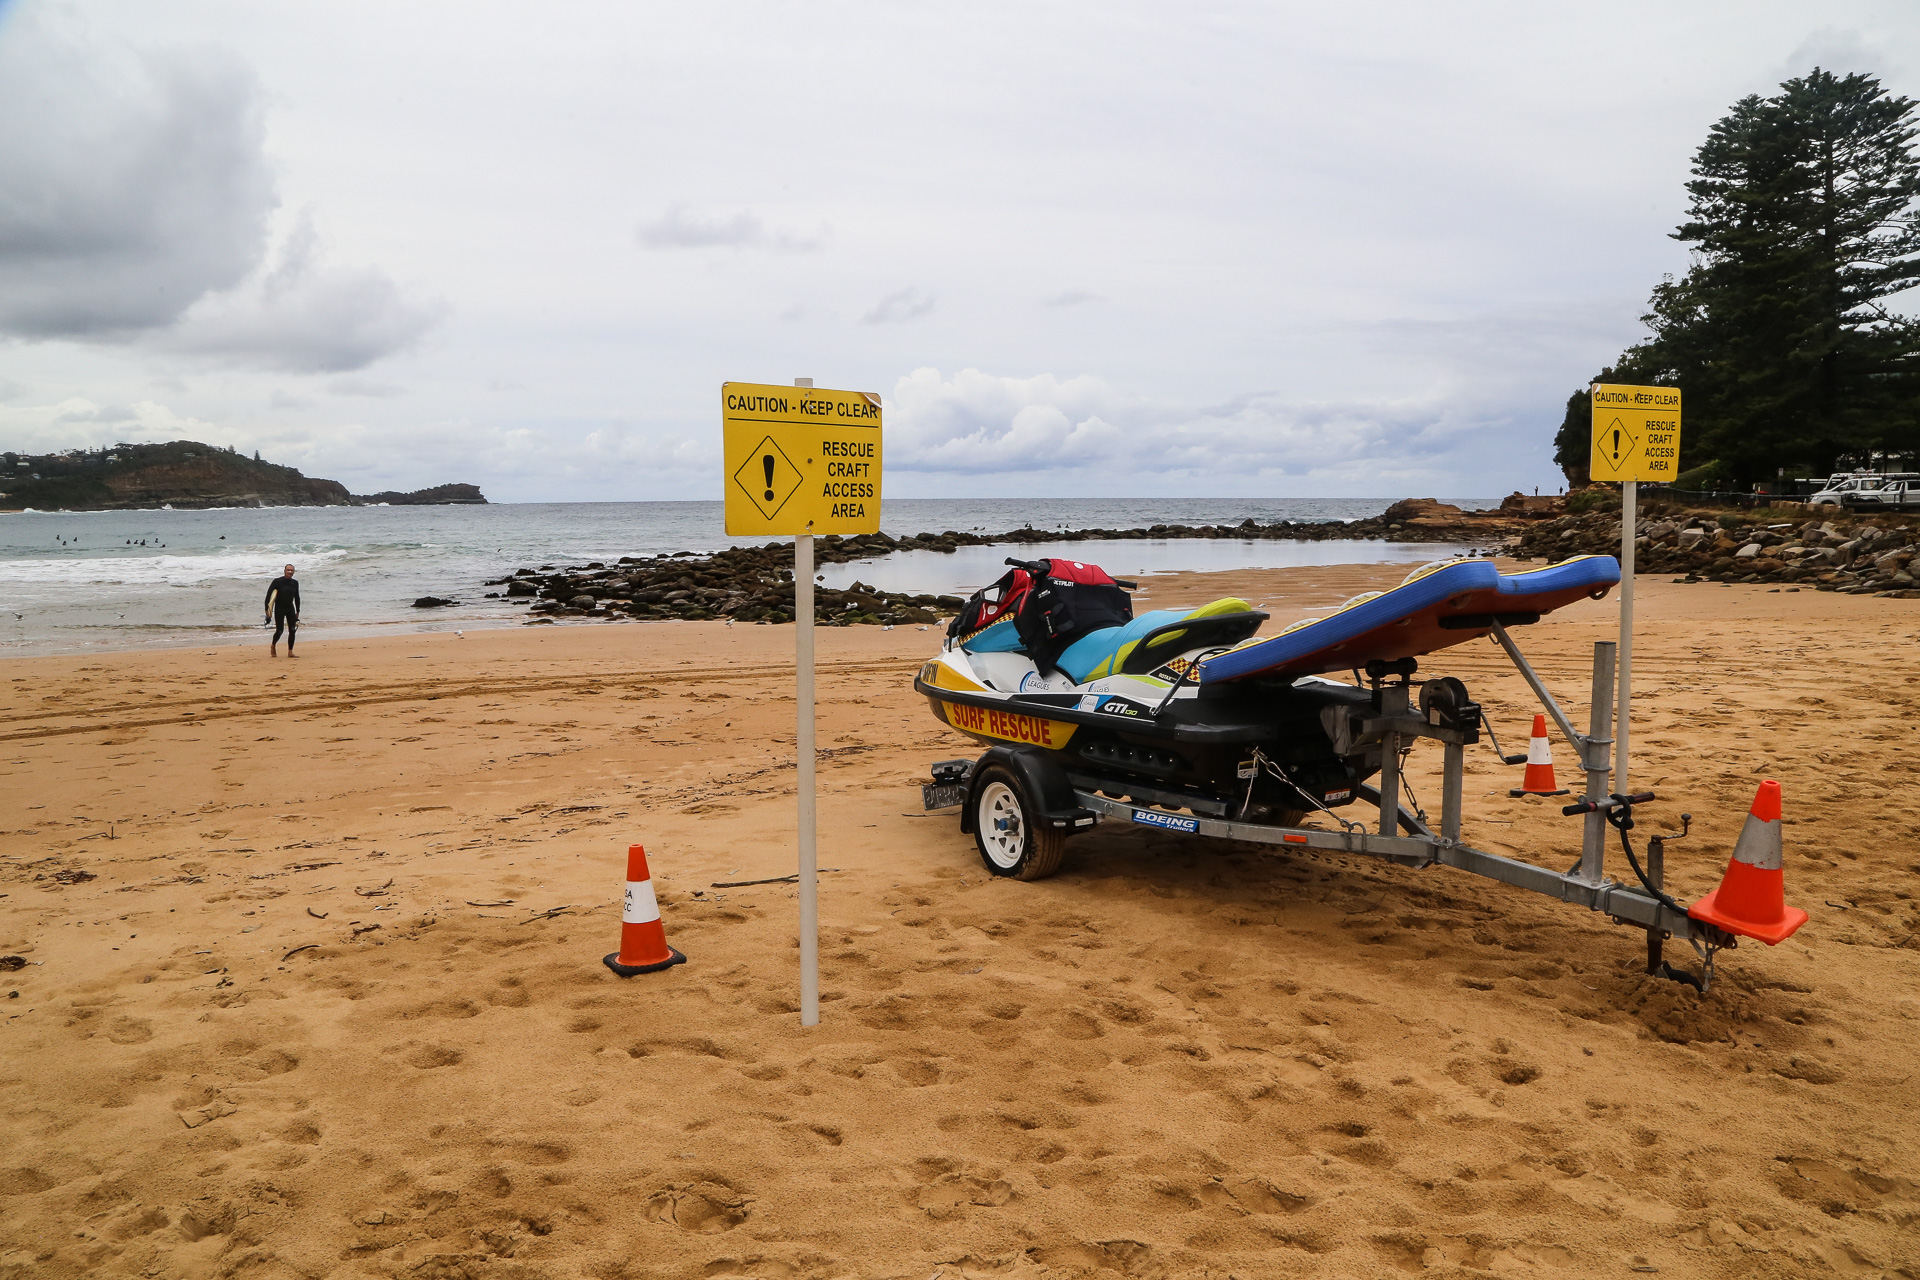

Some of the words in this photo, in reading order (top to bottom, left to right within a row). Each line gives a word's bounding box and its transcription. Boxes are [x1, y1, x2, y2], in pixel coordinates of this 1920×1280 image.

[1595, 391, 1628, 403] CAUTION
[1634, 393, 1653, 404] KEEP
[1654, 395, 1679, 406] CLEAR
[728, 394, 787, 413] CAUTION
[800, 399, 833, 416] KEEP
[837, 402, 878, 419] CLEAR
[1646, 420, 1676, 431] RESCUE
[1648, 434, 1673, 444] CRAFT
[822, 441, 874, 458] RESCUE
[1645, 447, 1675, 458] ACCESS
[828, 462, 870, 478] CRAFT
[1649, 461, 1669, 471] AREA
[822, 482, 874, 498] ACCESS
[831, 503, 865, 518] AREA
[1027, 680, 1050, 691] LEAGUES
[953, 702, 985, 731] SURF
[989, 709, 1052, 745] RESCUE
[1135, 811, 1196, 828] BOEING
